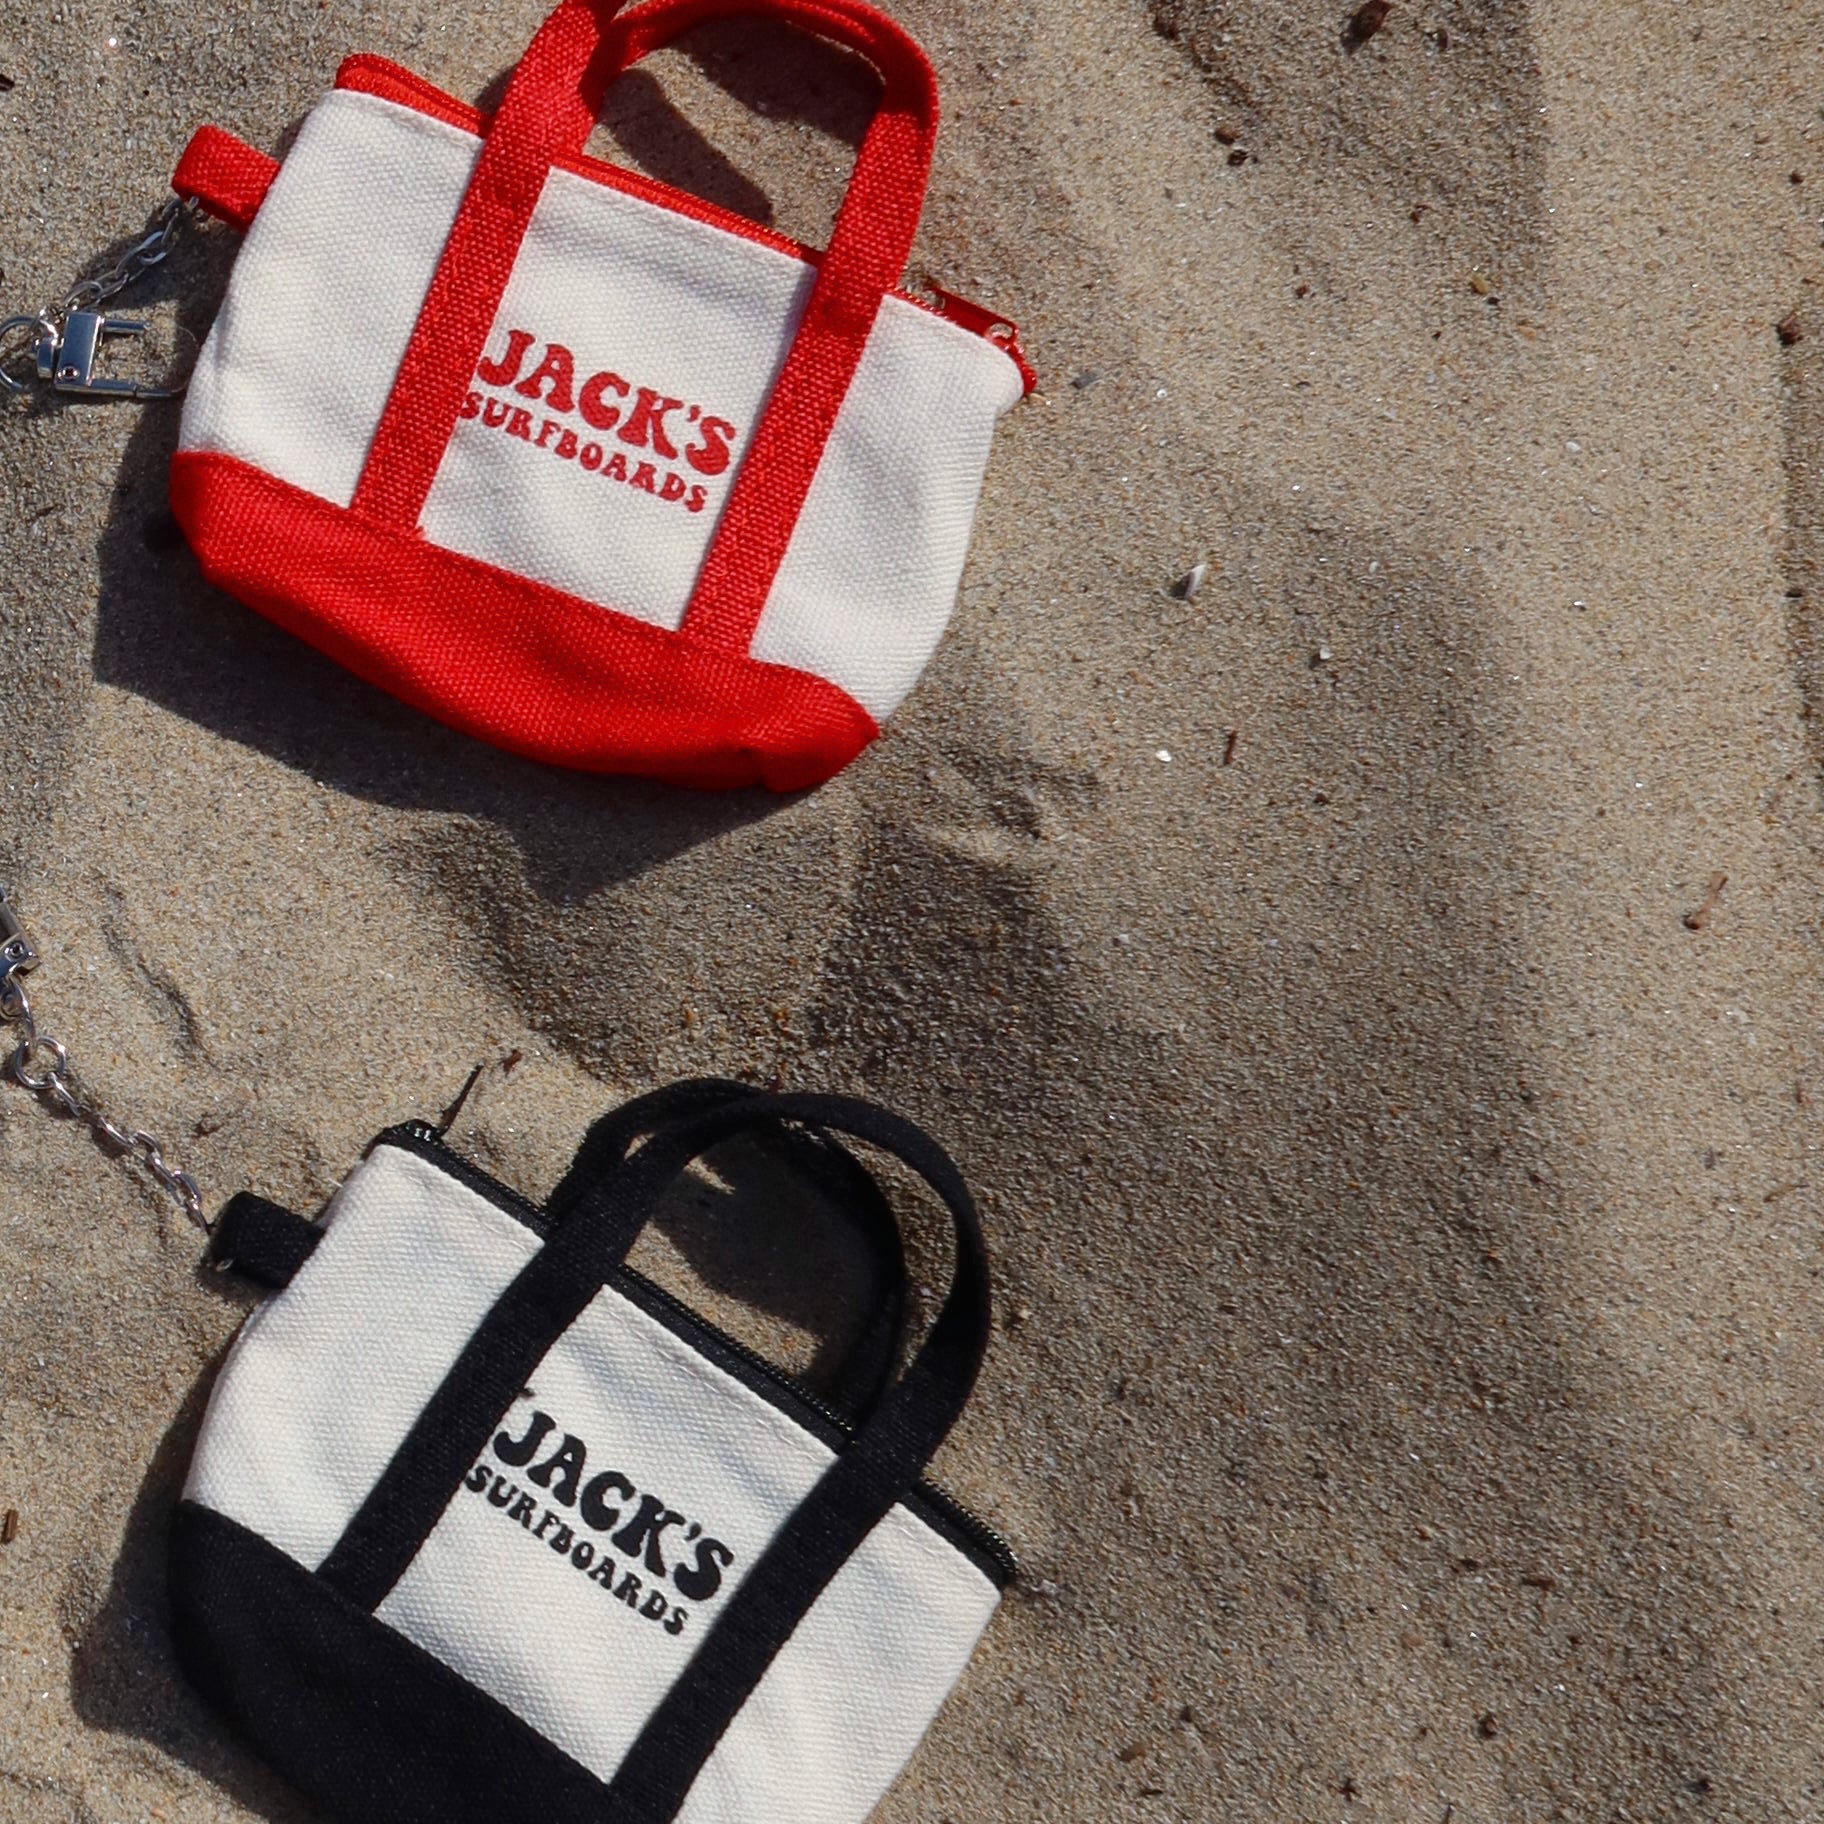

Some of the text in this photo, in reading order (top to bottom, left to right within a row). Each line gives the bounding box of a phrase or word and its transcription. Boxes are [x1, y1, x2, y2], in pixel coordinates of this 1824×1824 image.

[458, 391, 708, 513] SURFBOARDS
[476, 329, 736, 476] JACK'S
[463, 1465, 689, 1636] SURFBOARDS
[492, 1410, 734, 1602] JACK'S
